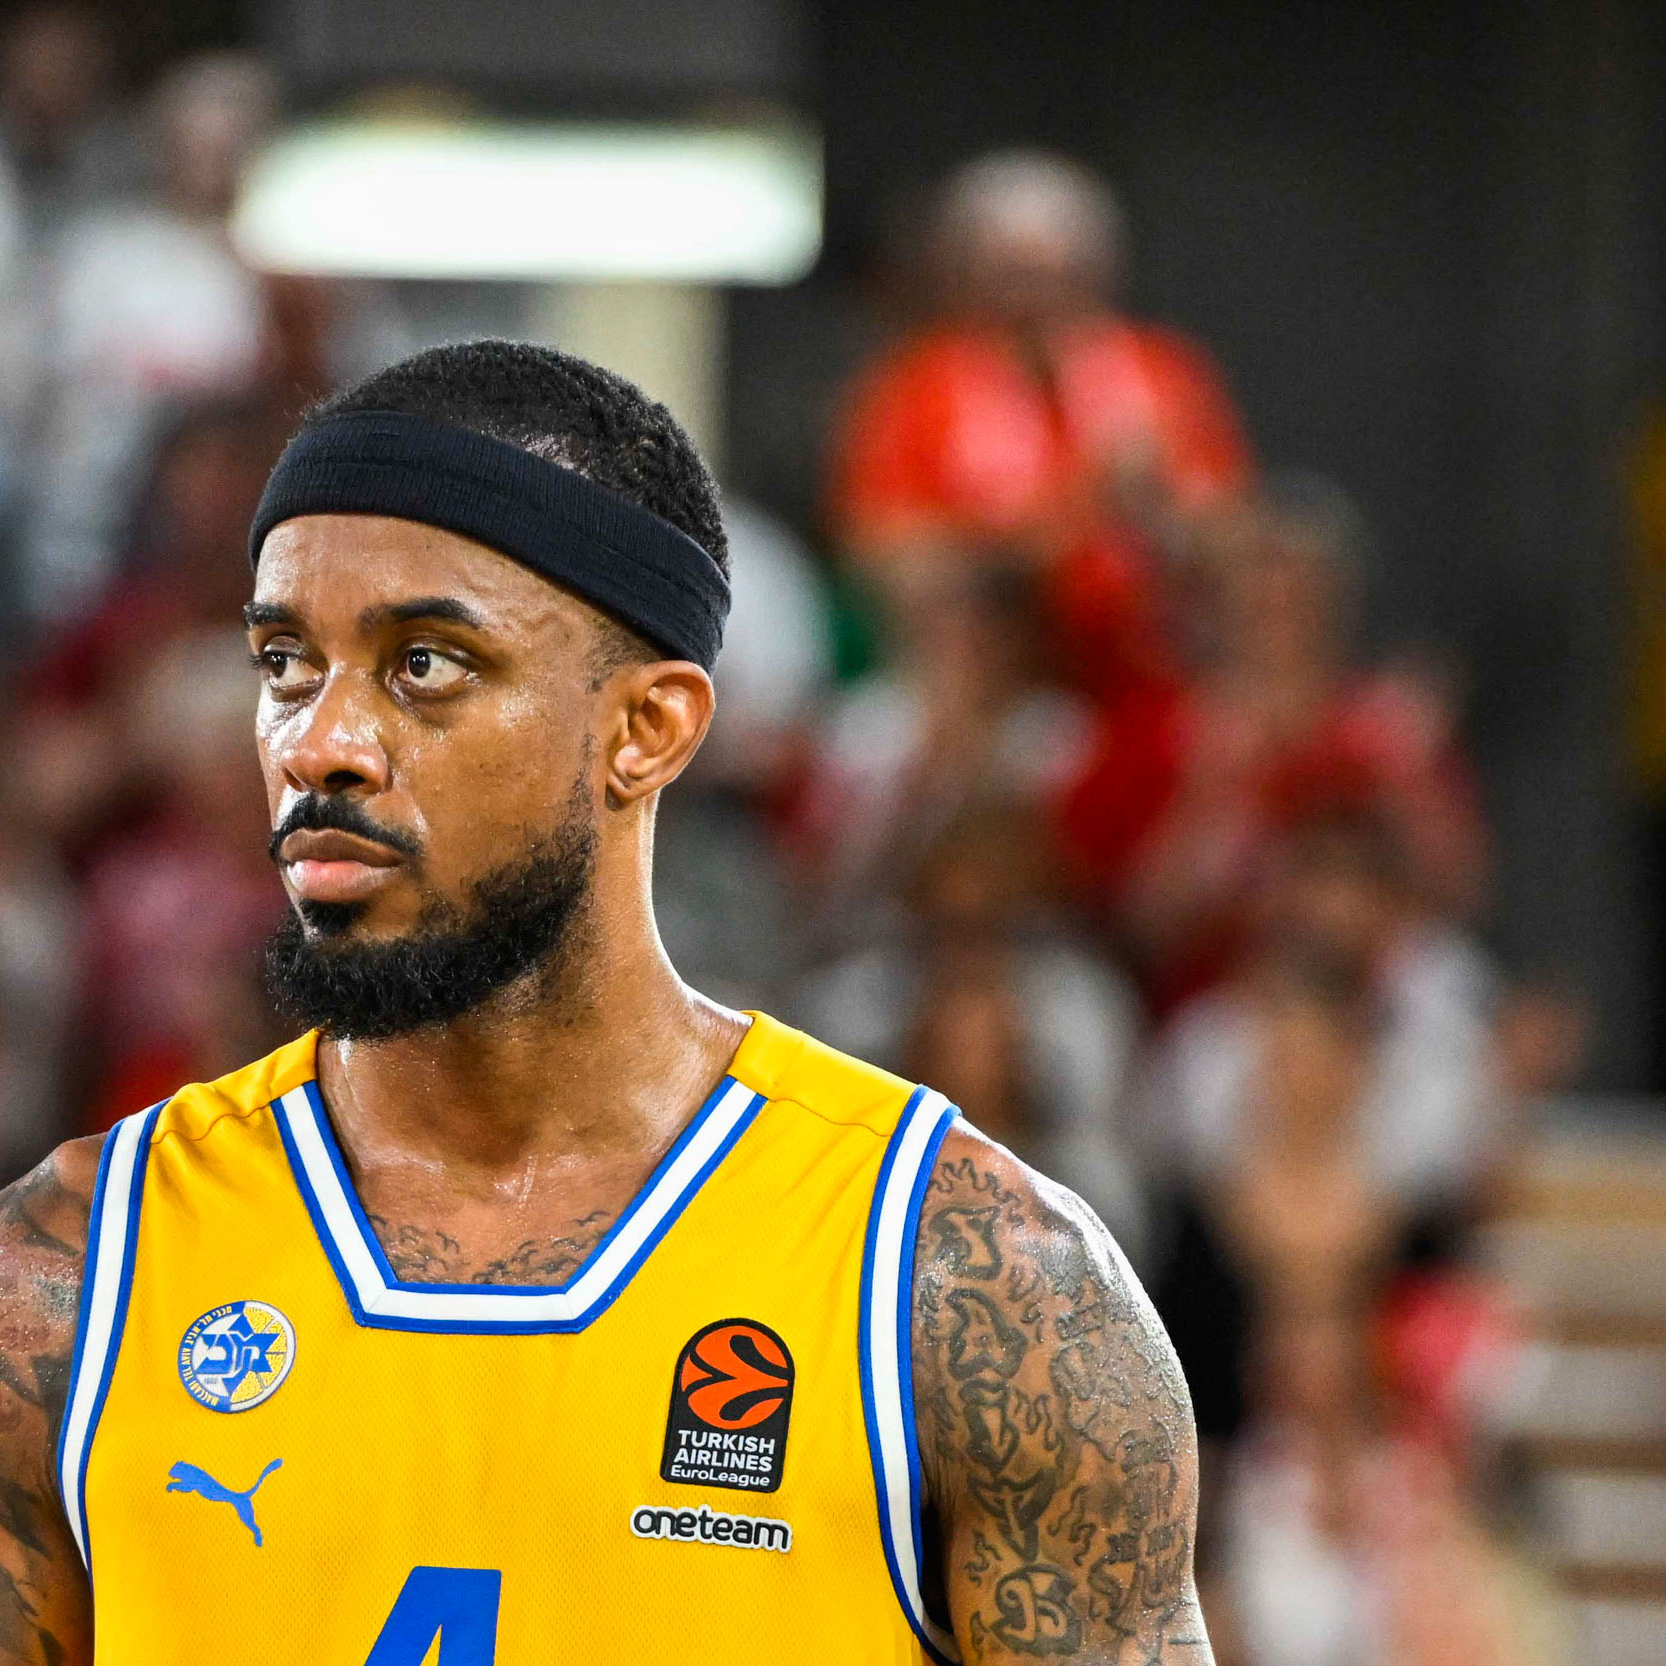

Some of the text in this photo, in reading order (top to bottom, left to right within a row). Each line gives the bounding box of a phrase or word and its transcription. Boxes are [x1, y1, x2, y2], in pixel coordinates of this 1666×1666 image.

[678, 1429, 776, 1455] TURKISH
[673, 1447, 774, 1473] AIRLINES
[670, 1464, 771, 1487] EuroLeague
